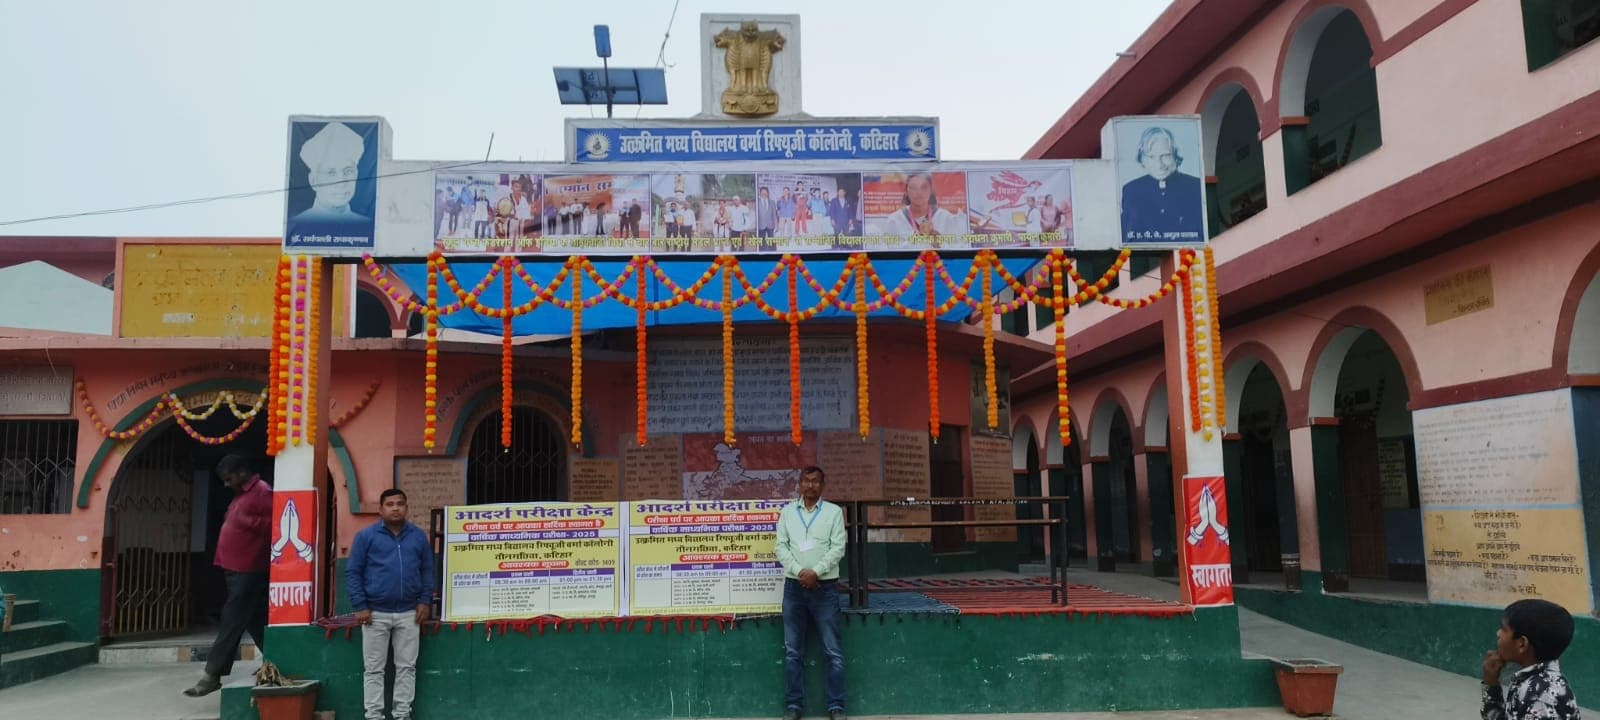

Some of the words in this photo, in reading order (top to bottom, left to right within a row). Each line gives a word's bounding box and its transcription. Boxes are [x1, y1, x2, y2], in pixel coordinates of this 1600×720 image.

[665, 136, 690, 152] मध्य
[692, 131, 737, 152] विद्यालय
[740, 130, 762, 152] वर्मा
[764, 129, 806, 158] रिफ्यूजी
[809, 128, 856, 154] कॉलोनी,
[860, 128, 900, 150] कटिहार
[456, 507, 512, 520] आदर्श
[516, 506, 572, 518] परीक्षा
[577, 504, 614, 518] केन्द्र
[637, 501, 690, 513] आदर्श
[696, 500, 750, 512] परीक्षा
[647, 516, 668, 524] परीक्षा
[670, 515, 682, 523] पर्व
[746, 513, 772, 522] स्वागत
[466, 522, 488, 531] परीक्षा
[490, 522, 502, 530] पर्व
[515, 522, 542, 530] आपका
[568, 520, 594, 528] स्वागत
[652, 524, 678, 533] वार्षिक
[680, 524, 719, 533] माध्यमिक
[470, 531, 497, 541] वार्षिक
[499, 530, 541, 541] माध्यमिक
[668, 536, 683, 544] मध्य
[685, 534, 714, 542] विद्यालय
[745, 532, 760, 542] वर्मा
[504, 541, 534, 550] विद्यालय
[566, 540, 581, 548] वर्मा
[582, 538, 614, 548] कॉलोनी
[723, 544, 752, 552] कटिहार
[544, 550, 572, 560] कटिहार
[682, 554, 720, 562] आवश्यक
[721, 553, 746, 562] सूचना
[501, 560, 540, 569] आवश्यक
[542, 560, 567, 569] सूचना
